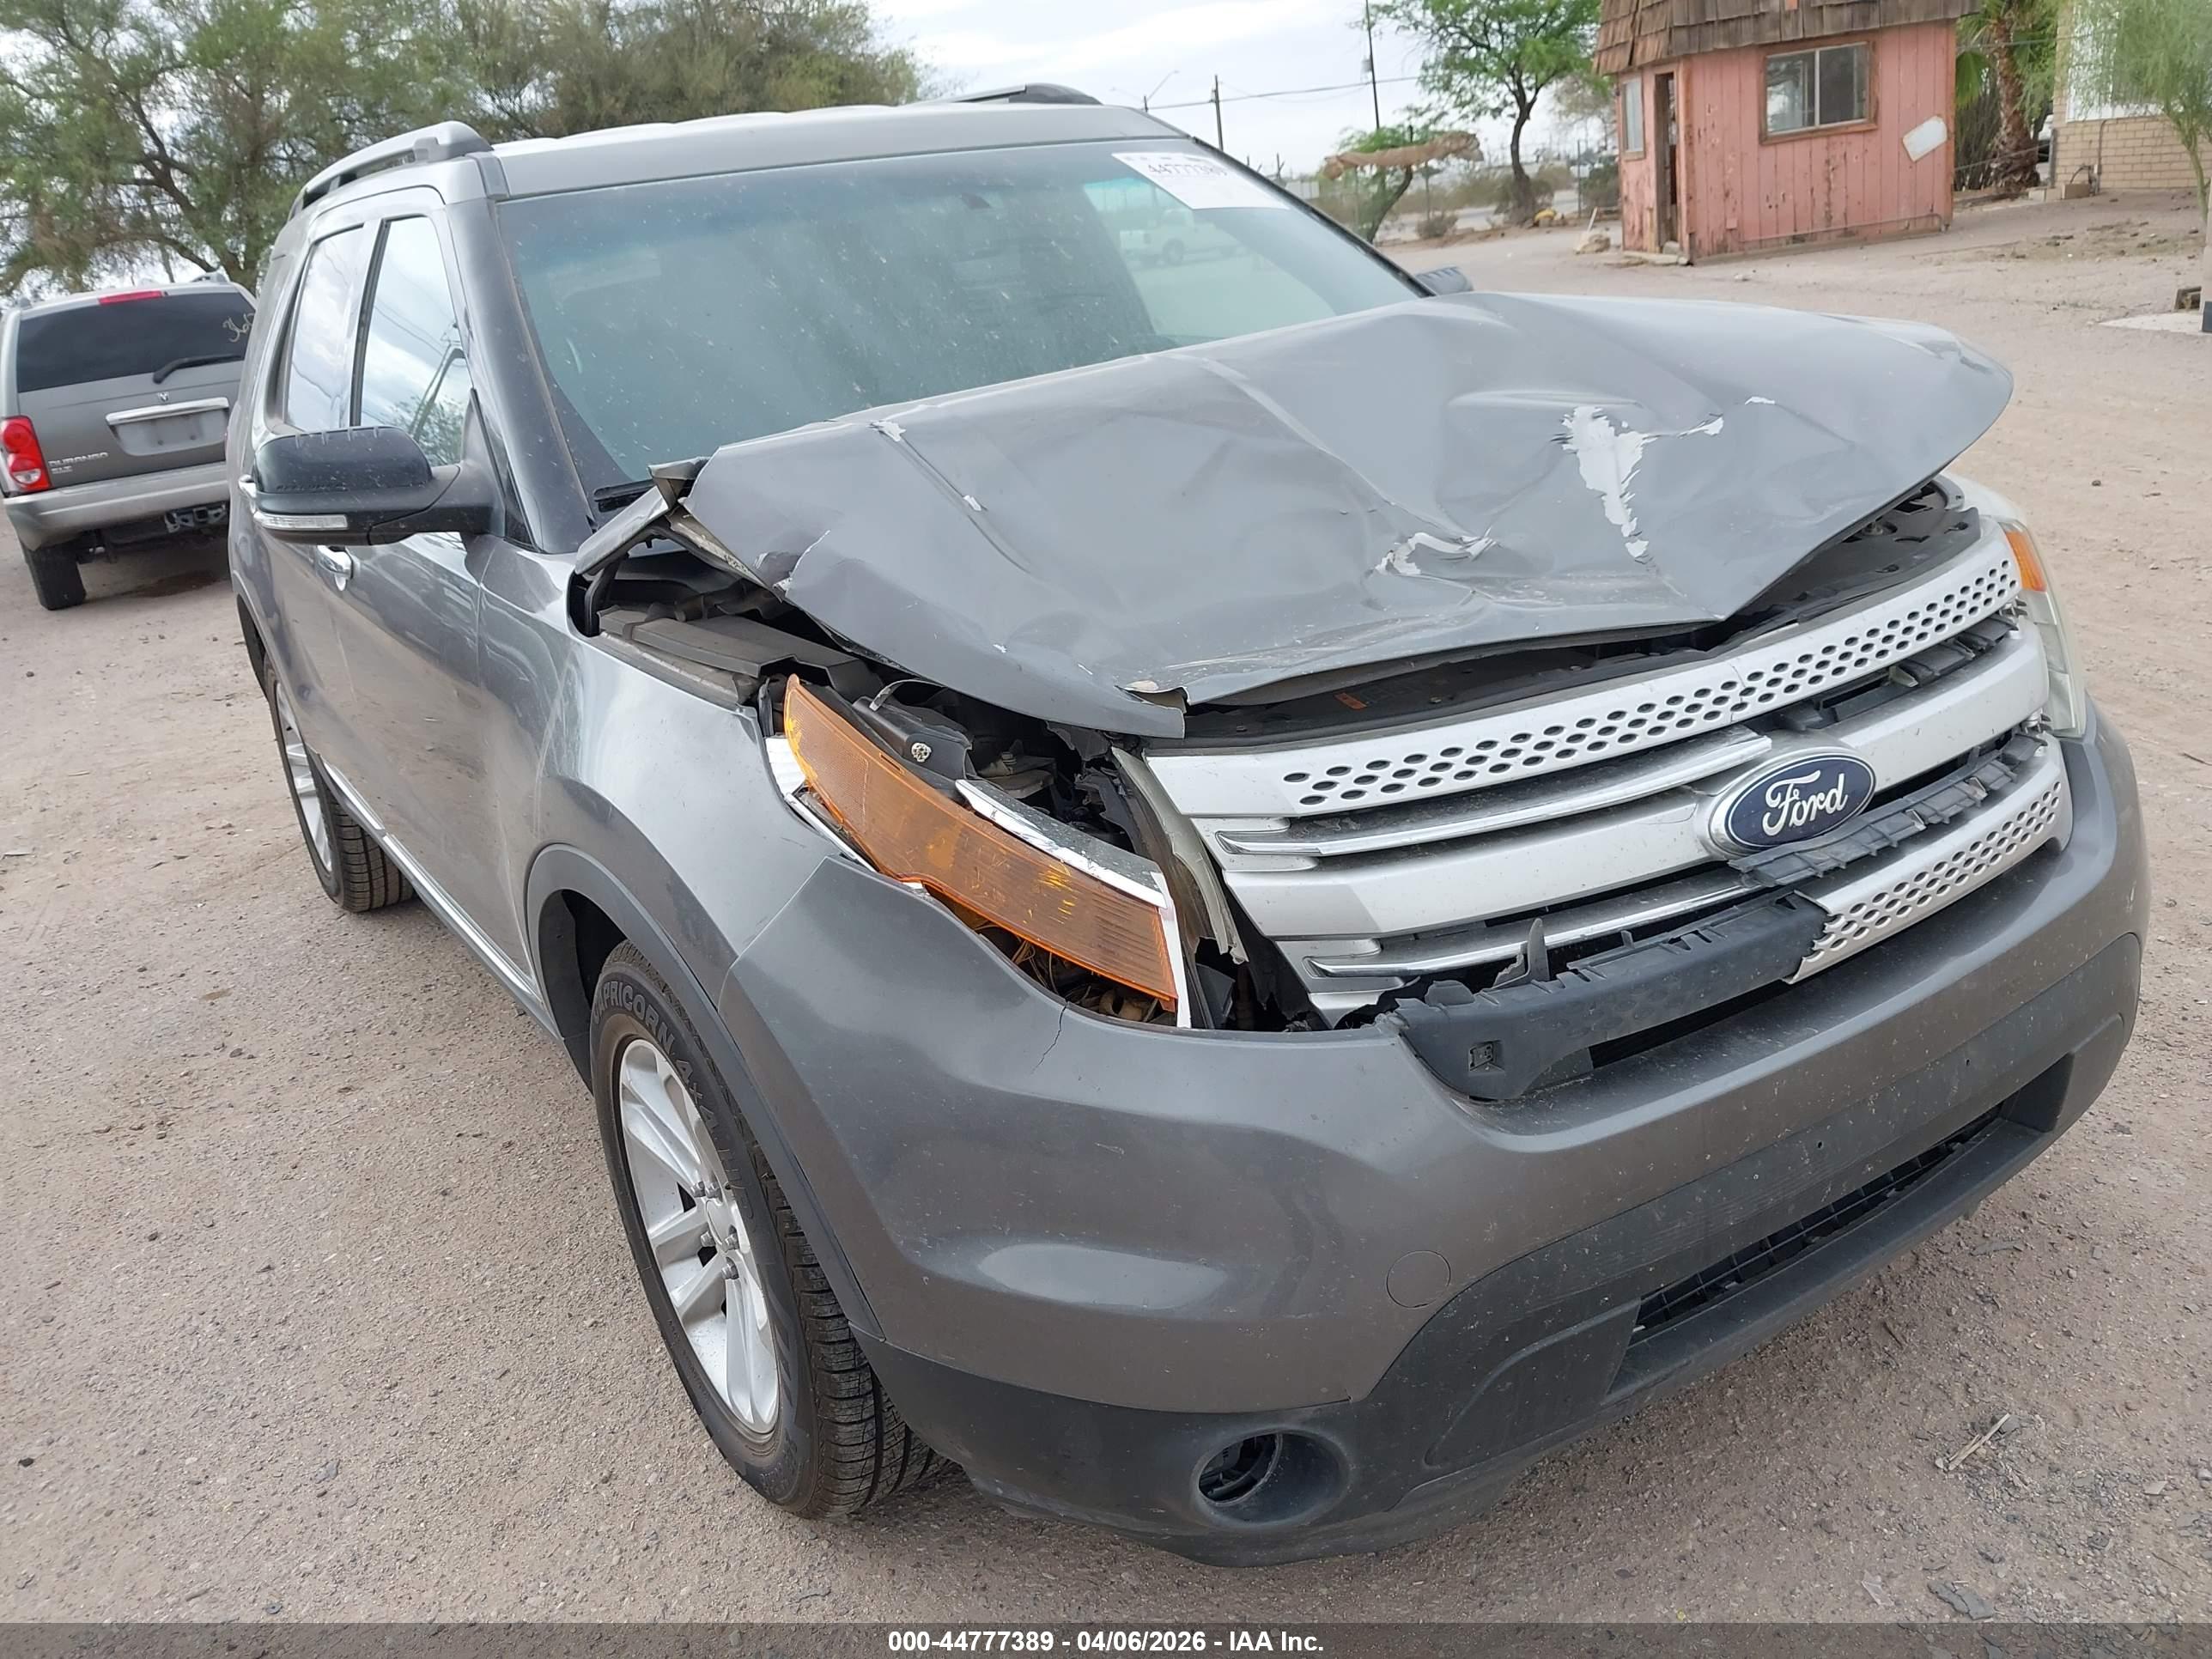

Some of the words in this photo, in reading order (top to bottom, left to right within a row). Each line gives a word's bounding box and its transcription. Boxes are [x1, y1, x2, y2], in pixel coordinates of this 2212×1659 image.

[47, 452, 109, 467] DURANGO
[1761, 769, 1849, 836] Ford
[592, 980, 676, 1056] CAPRICORN
